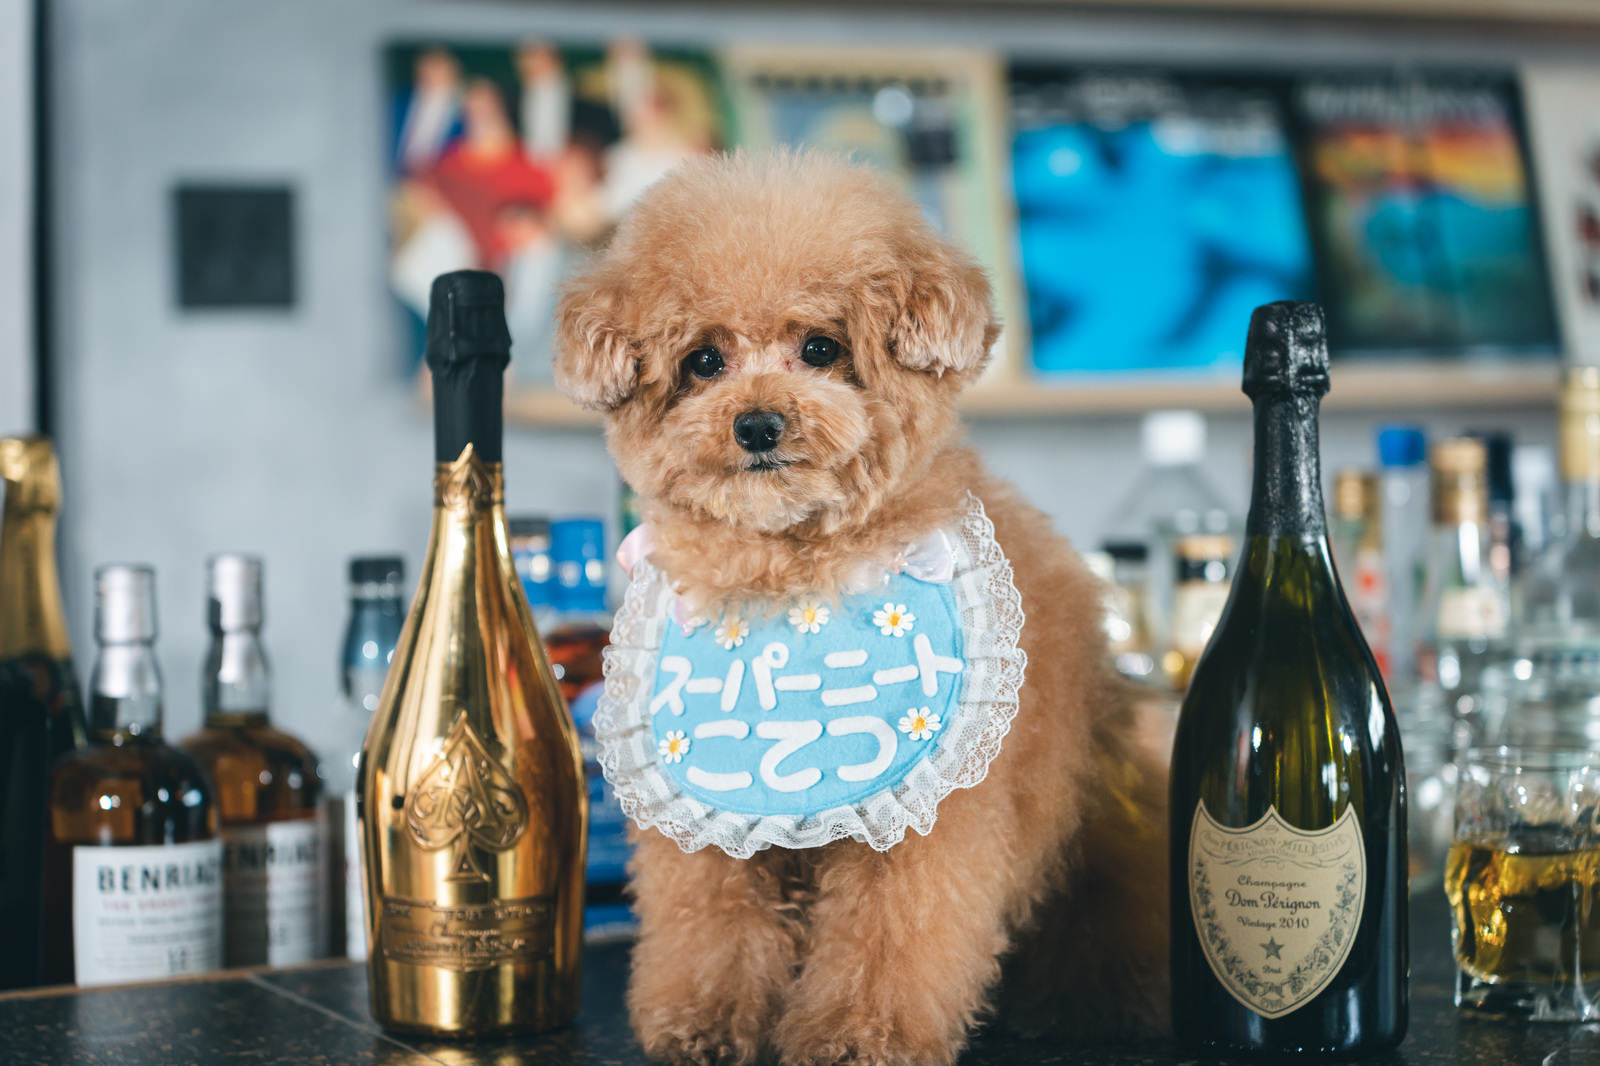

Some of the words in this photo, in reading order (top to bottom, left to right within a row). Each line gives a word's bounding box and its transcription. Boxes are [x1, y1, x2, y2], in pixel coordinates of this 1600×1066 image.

[686, 715, 899, 793] こてつ
[1237, 874, 1307, 891] Champagne
[1225, 888, 1259, 909] Dom
[1236, 915, 1276, 931] Vintage
[1278, 917, 1309, 930] 2010
